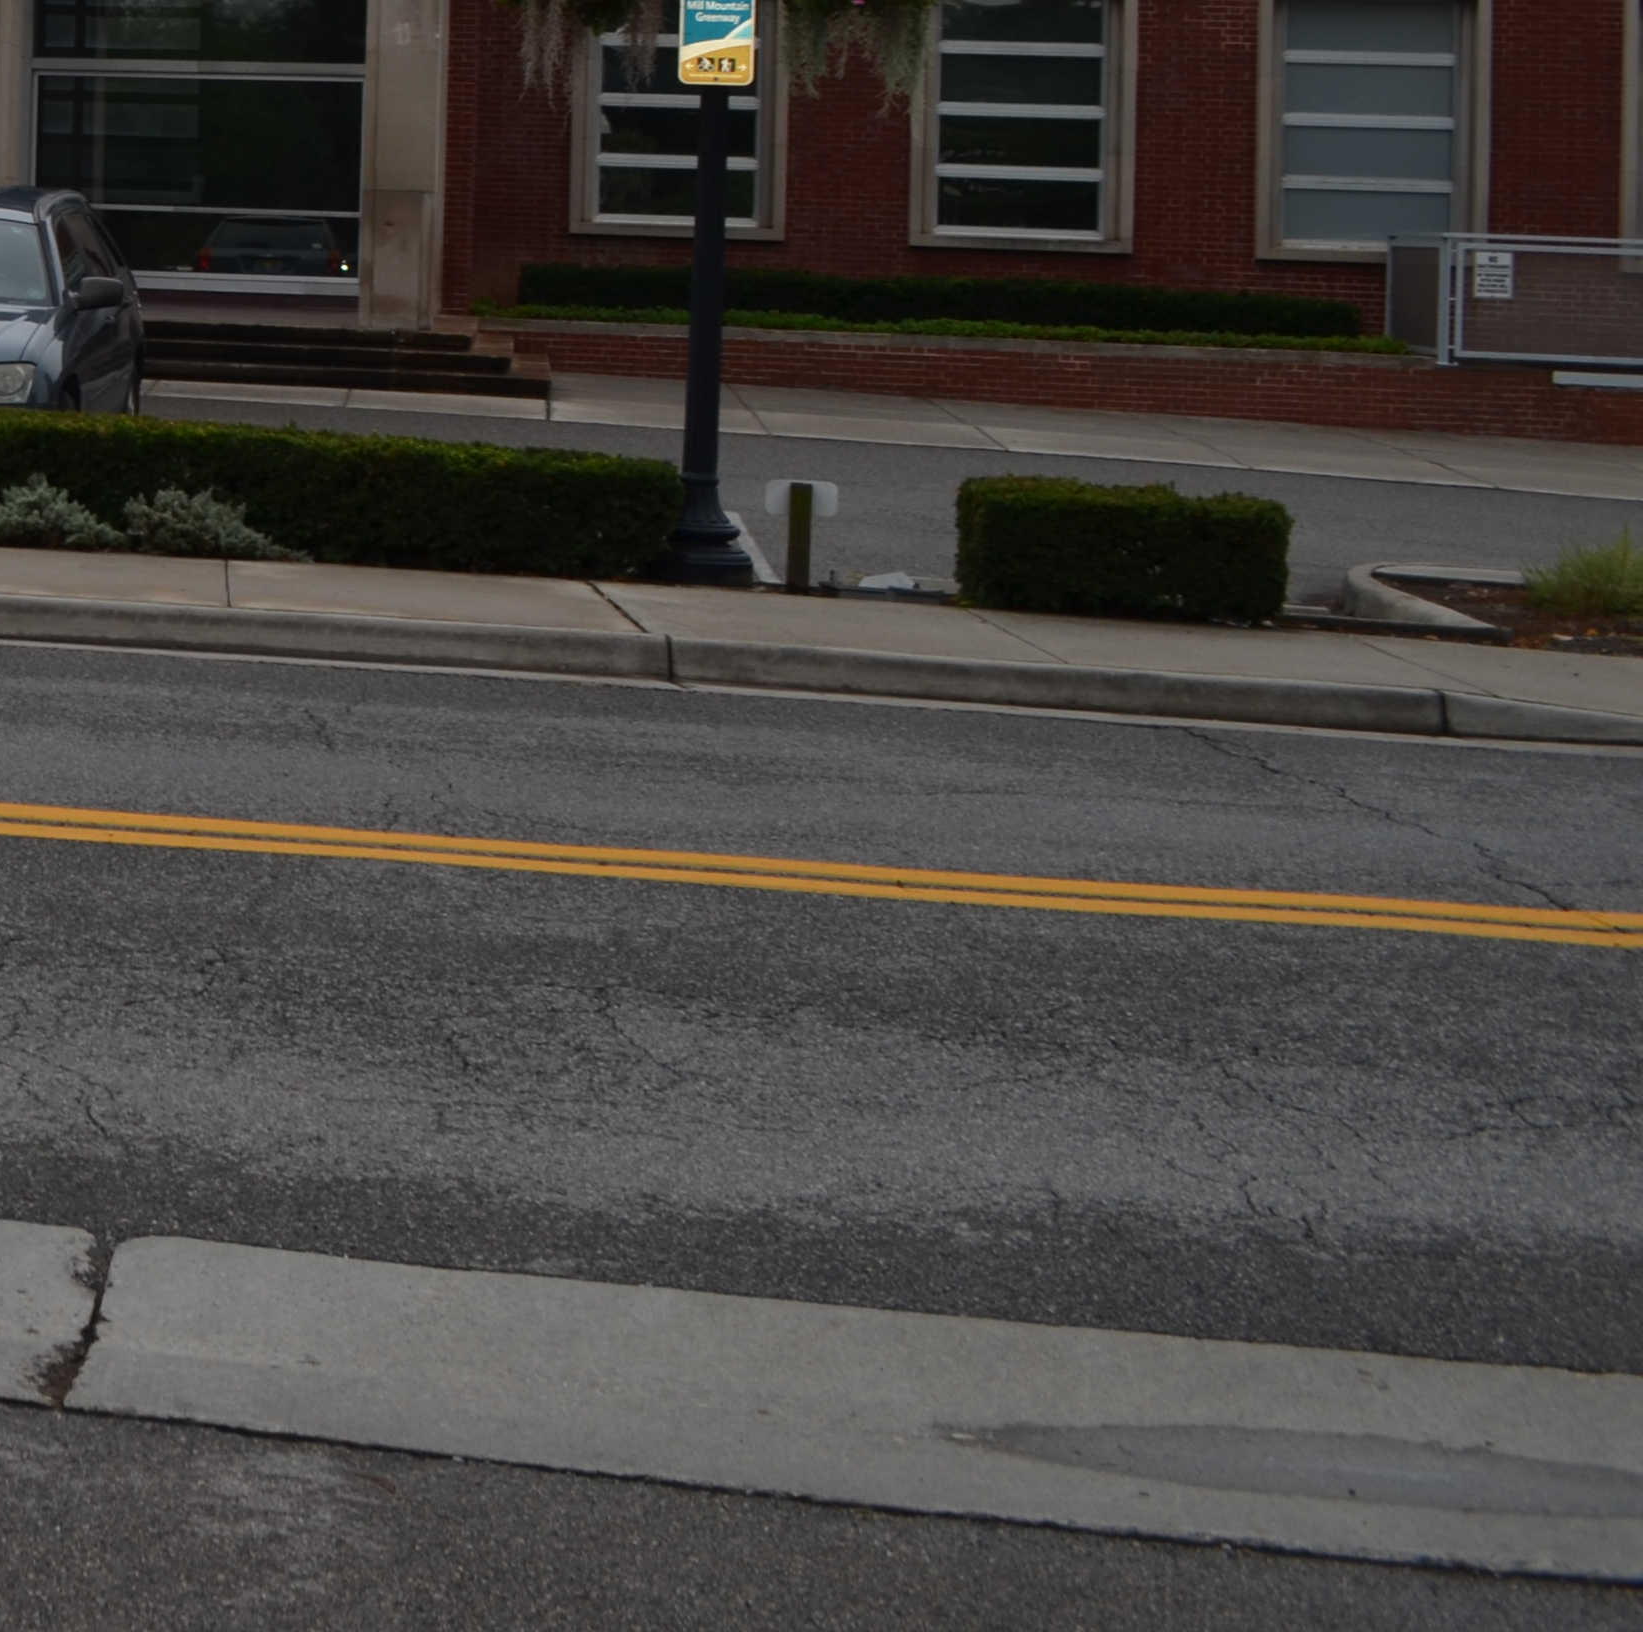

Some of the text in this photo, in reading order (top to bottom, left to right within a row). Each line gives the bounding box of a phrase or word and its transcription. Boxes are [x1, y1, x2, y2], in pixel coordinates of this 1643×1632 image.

[687, 0, 750, 11] Mill Mountain
[695, 11, 741, 25] Greenway
